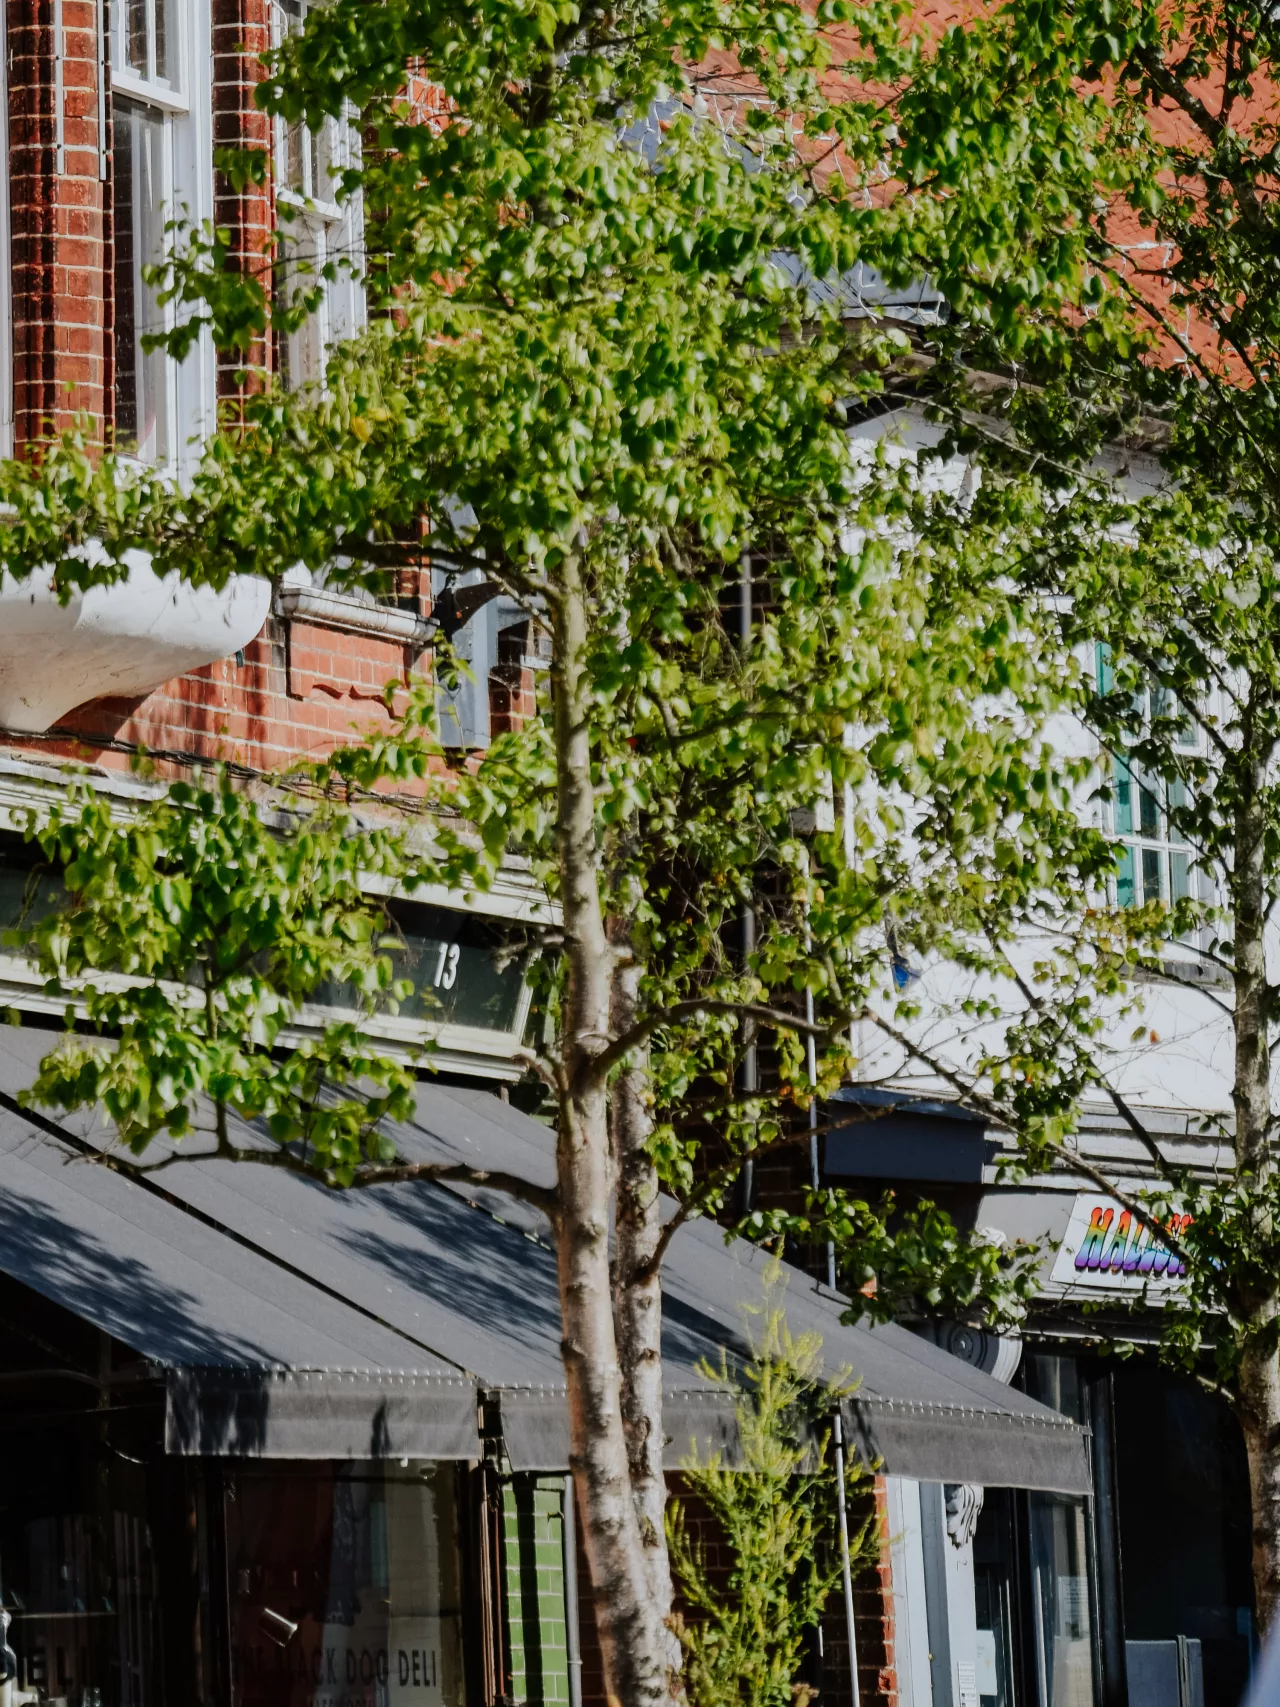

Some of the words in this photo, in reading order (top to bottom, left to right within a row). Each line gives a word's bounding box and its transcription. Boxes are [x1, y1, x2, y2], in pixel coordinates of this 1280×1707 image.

[433, 942, 461, 990] 13
[345, 1647, 389, 1686] DOG
[398, 1649, 437, 1687] DELI
